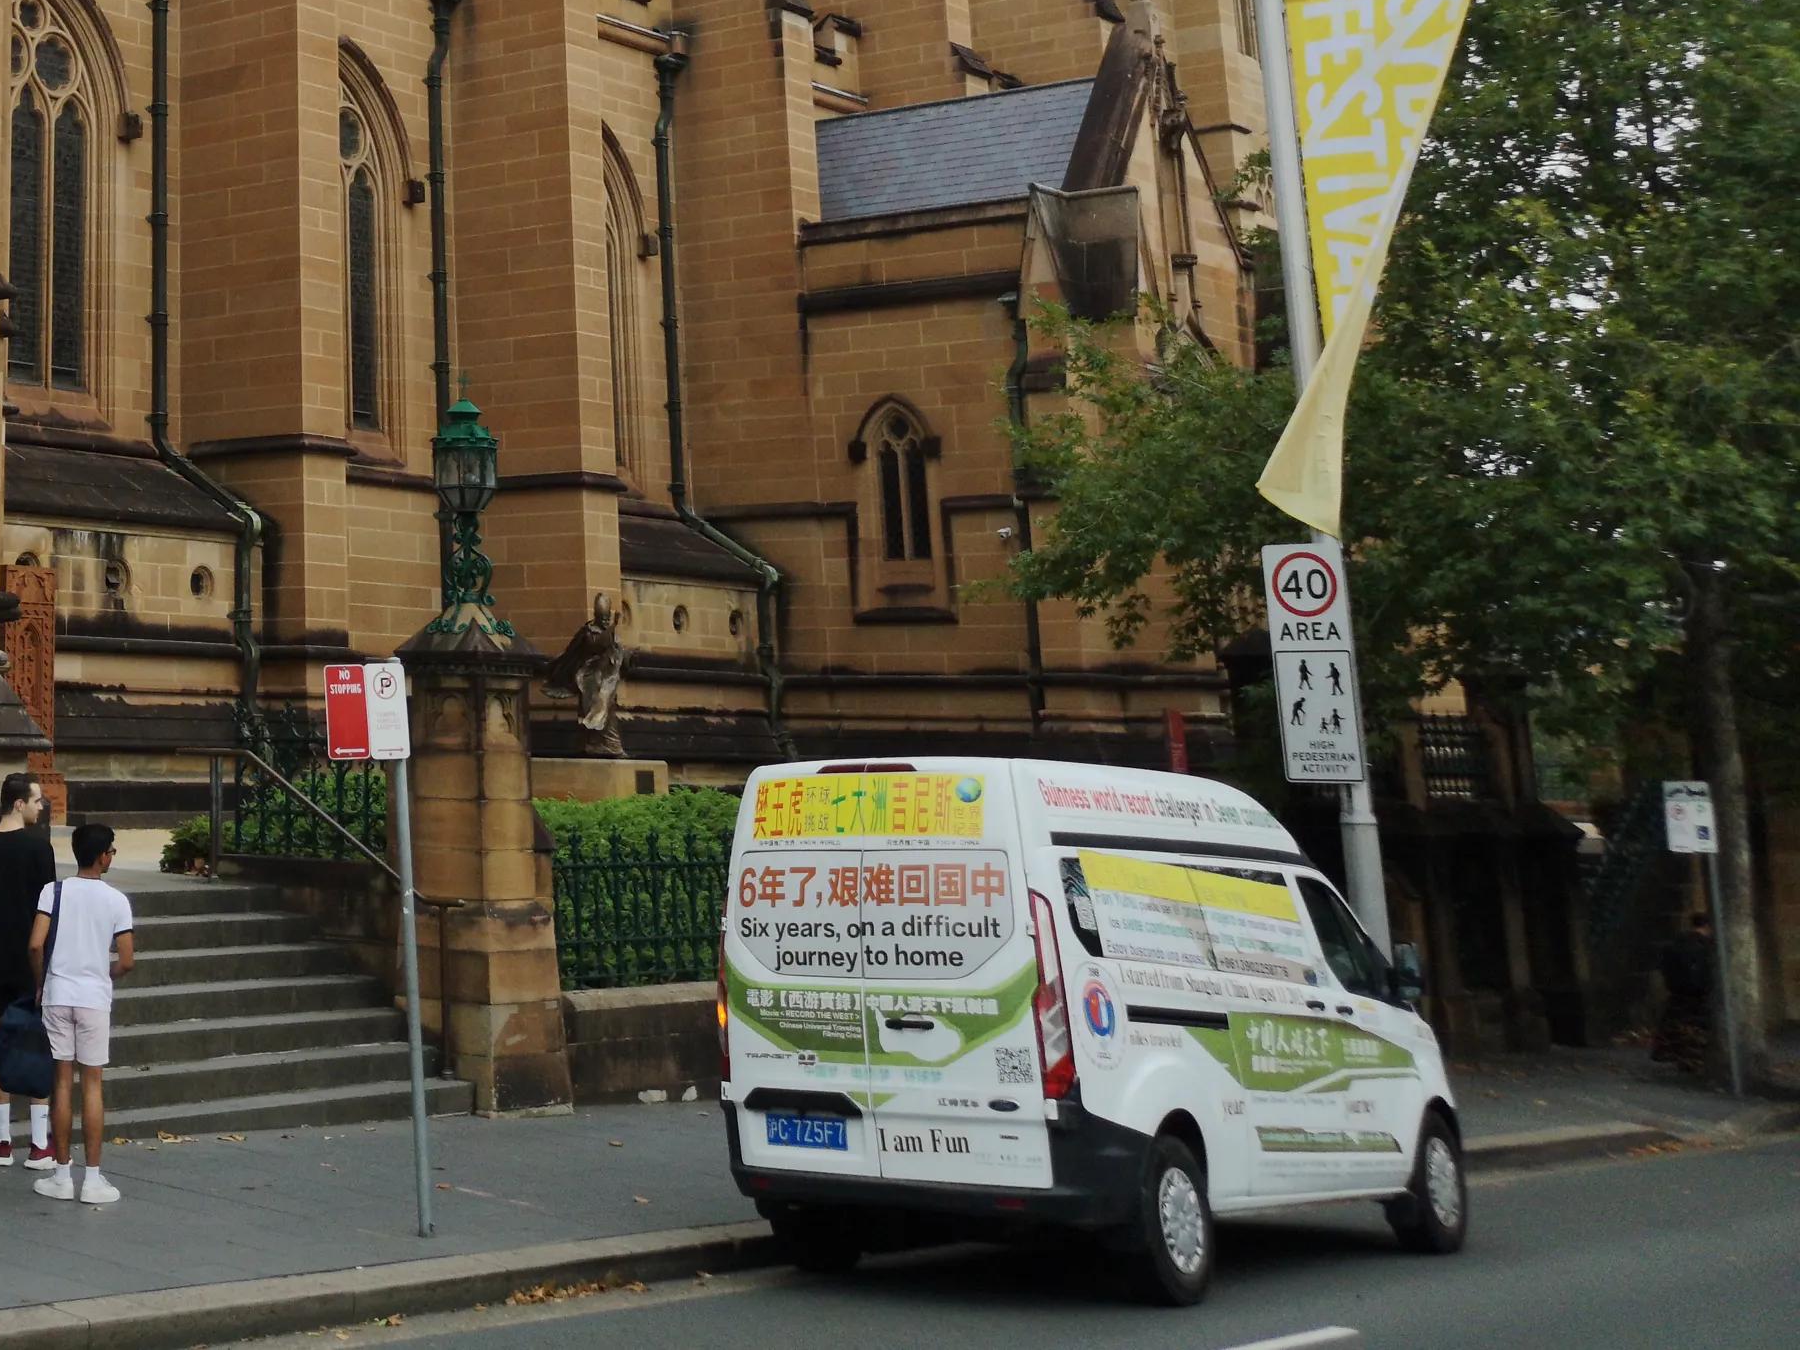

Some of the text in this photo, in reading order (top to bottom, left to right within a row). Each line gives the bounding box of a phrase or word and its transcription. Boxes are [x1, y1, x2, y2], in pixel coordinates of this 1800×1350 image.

[1281, 568, 1328, 600] 40
[1280, 622, 1341, 642] AREA
[338, 669, 351, 681] NO
[329, 683, 362, 695] STOPPING
[1309, 740, 1336, 750] HIGH
[1292, 752, 1356, 762] PEDESTRIAN
[1300, 763, 1350, 774] ACTIVITY
[1037, 778, 1092, 811] Guinness
[1090, 786, 1123, 813] world
[1121, 791, 1157, 817] record
[1154, 792, 1202, 826] challenger
[741, 915, 1001, 942] Six years, on a difficult
[775, 944, 964, 972] journey to home
[816, 1011, 832, 1020] THE
[832, 1012, 854, 1020] WEST
[878, 1128, 971, 1154] I am Fun
